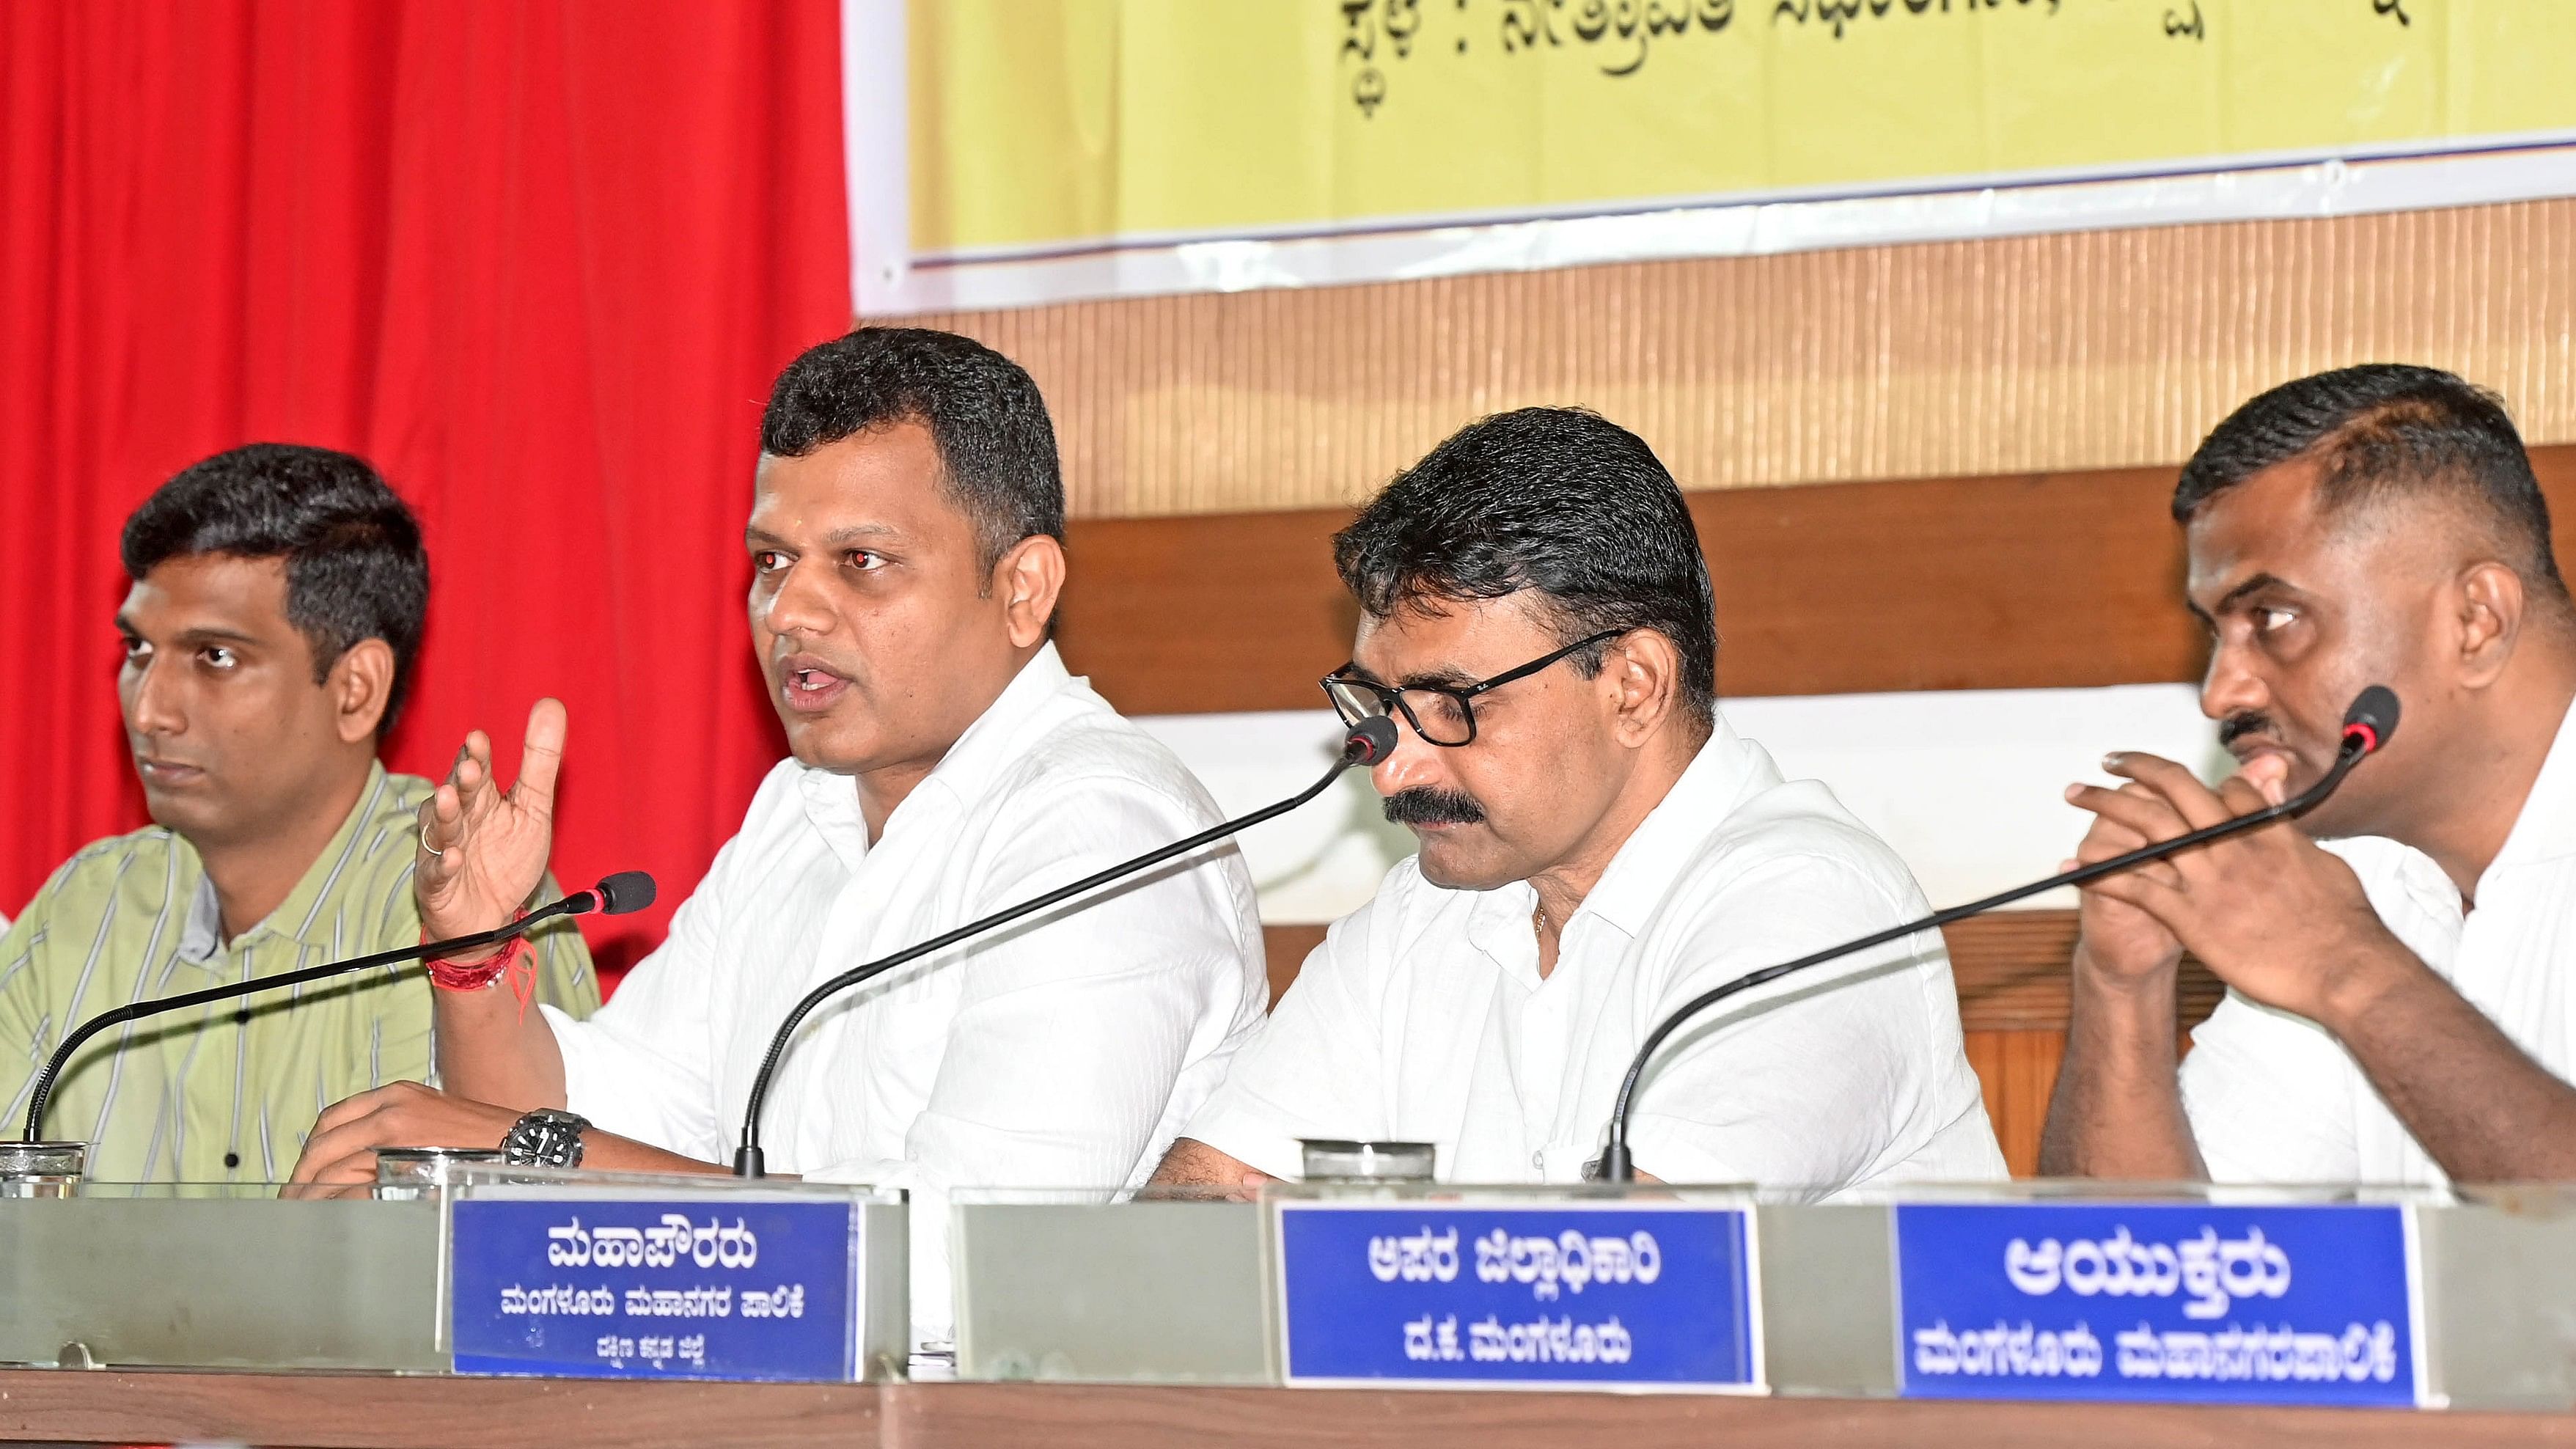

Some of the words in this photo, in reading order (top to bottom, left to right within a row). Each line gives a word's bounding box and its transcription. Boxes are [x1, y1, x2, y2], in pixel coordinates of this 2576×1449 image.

[547, 1214, 758, 1269] ಮಹಾಪೌರರು
[1368, 1225, 1460, 1283] ಅಪರ
[1474, 1228, 1662, 1301] ಜಿಲ್ಲಾಧಿಕಾರಿ
[500, 1283, 614, 1316] ಮಂಗಳೂರು
[624, 1285, 733, 1318] ಮಹಾನಗರ
[740, 1283, 805, 1319] ಪಾಲಿಕೆ
[2005, 1225, 2291, 1320] ಆಯುಕ್ತರು
[1403, 1315, 1465, 1361] ದ.ಕ.
[1469, 1315, 1632, 1364] ಮಂಗಳೂರು
[1912, 1319, 2103, 1377] ಮಂಗಳೂರು
[2115, 1320, 2397, 1383] ಮಹಾನಗರಪಾಲಿಕೆ
